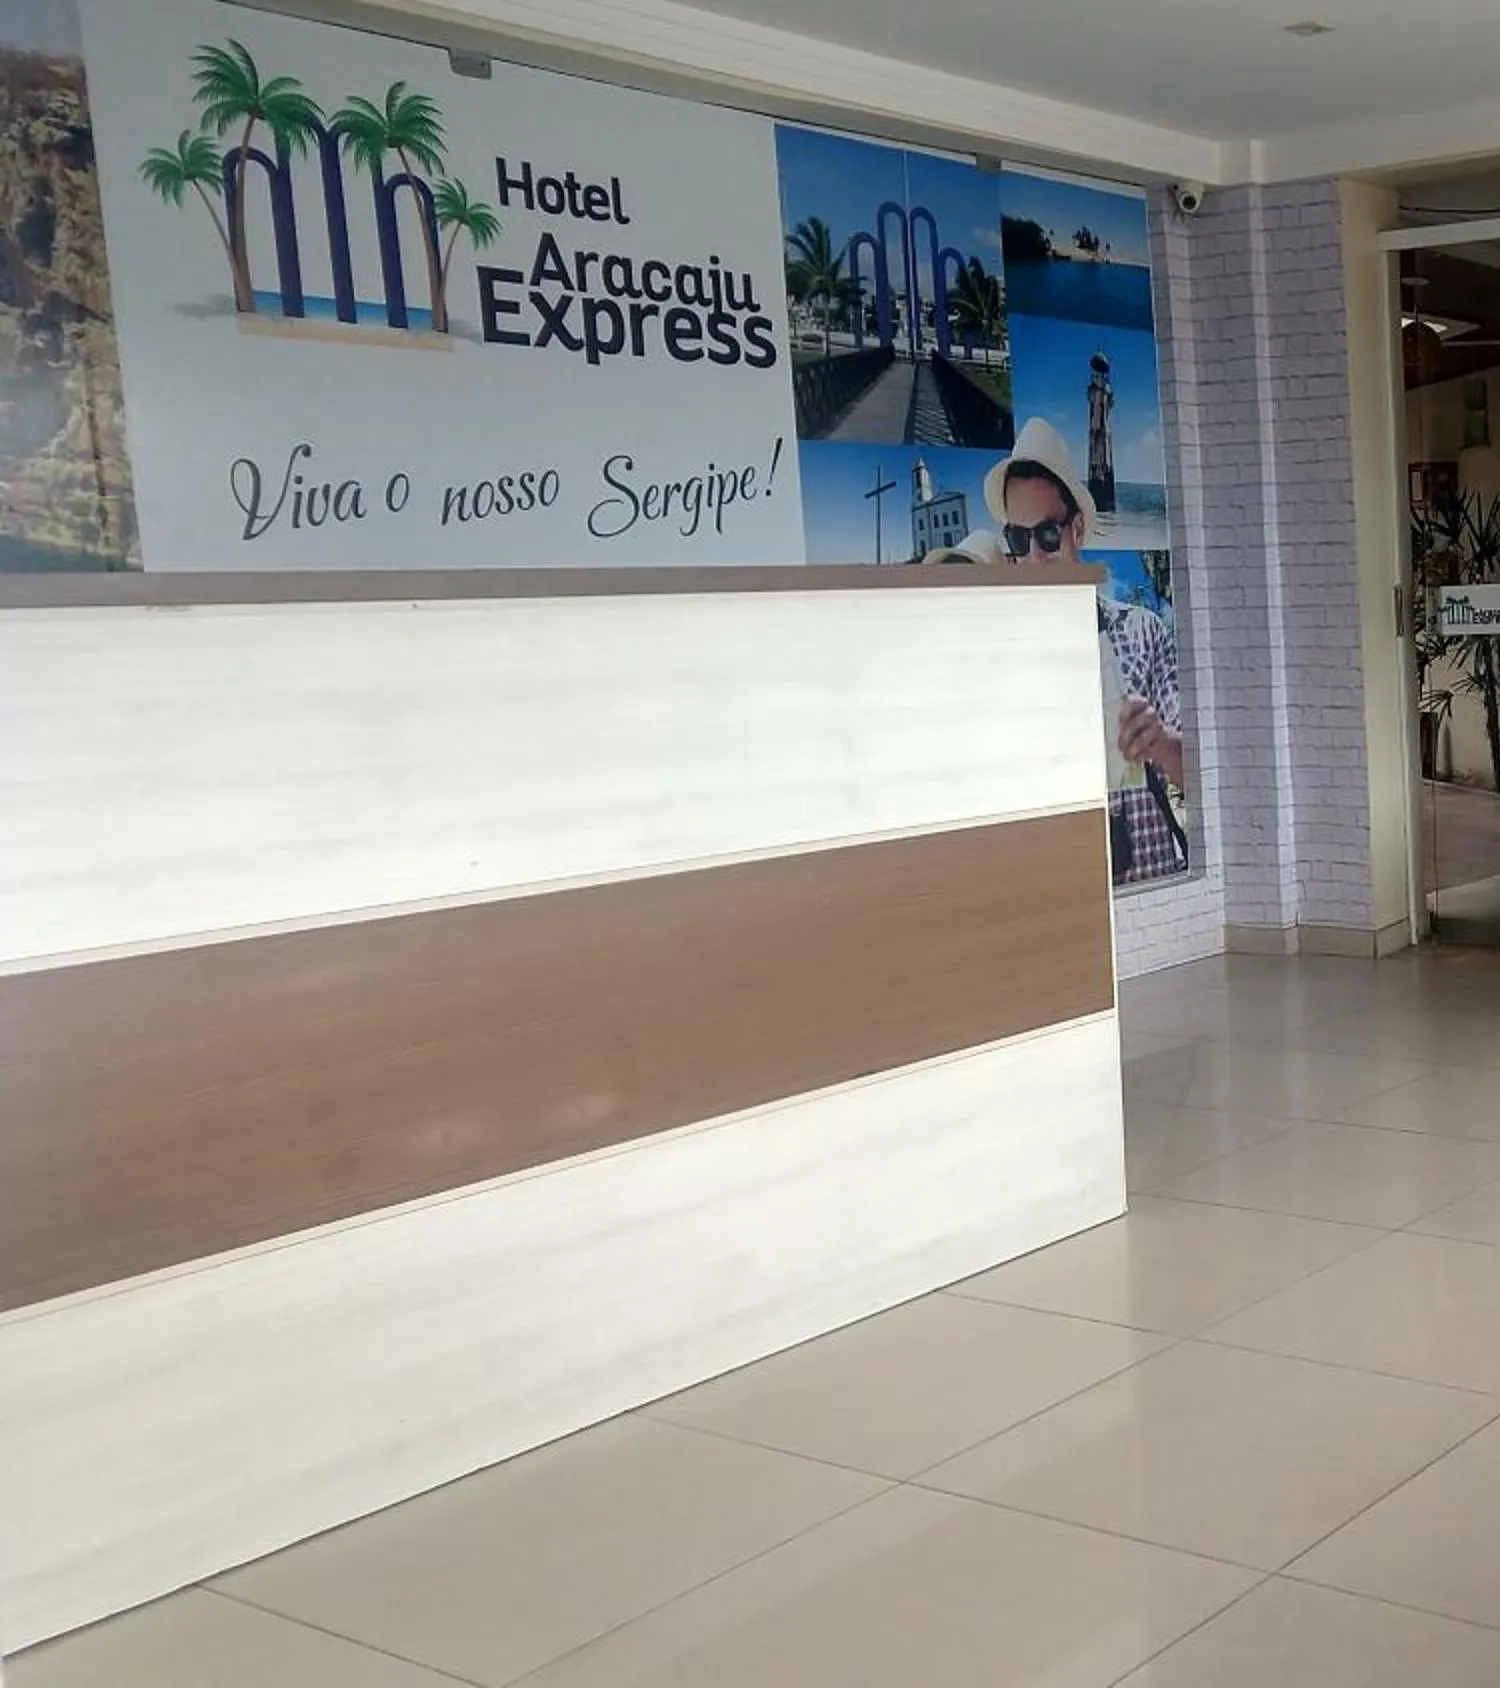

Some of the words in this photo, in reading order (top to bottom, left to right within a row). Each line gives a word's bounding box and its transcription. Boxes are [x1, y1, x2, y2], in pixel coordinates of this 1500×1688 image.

[495, 156, 630, 225] Hotel
[476, 265, 776, 369] Express
[529, 231, 760, 313] Aracaju
[230, 443, 367, 540] Viva
[385, 472, 410, 513] o
[441, 469, 559, 526] nosso
[587, 437, 783, 538] Sergipe!
